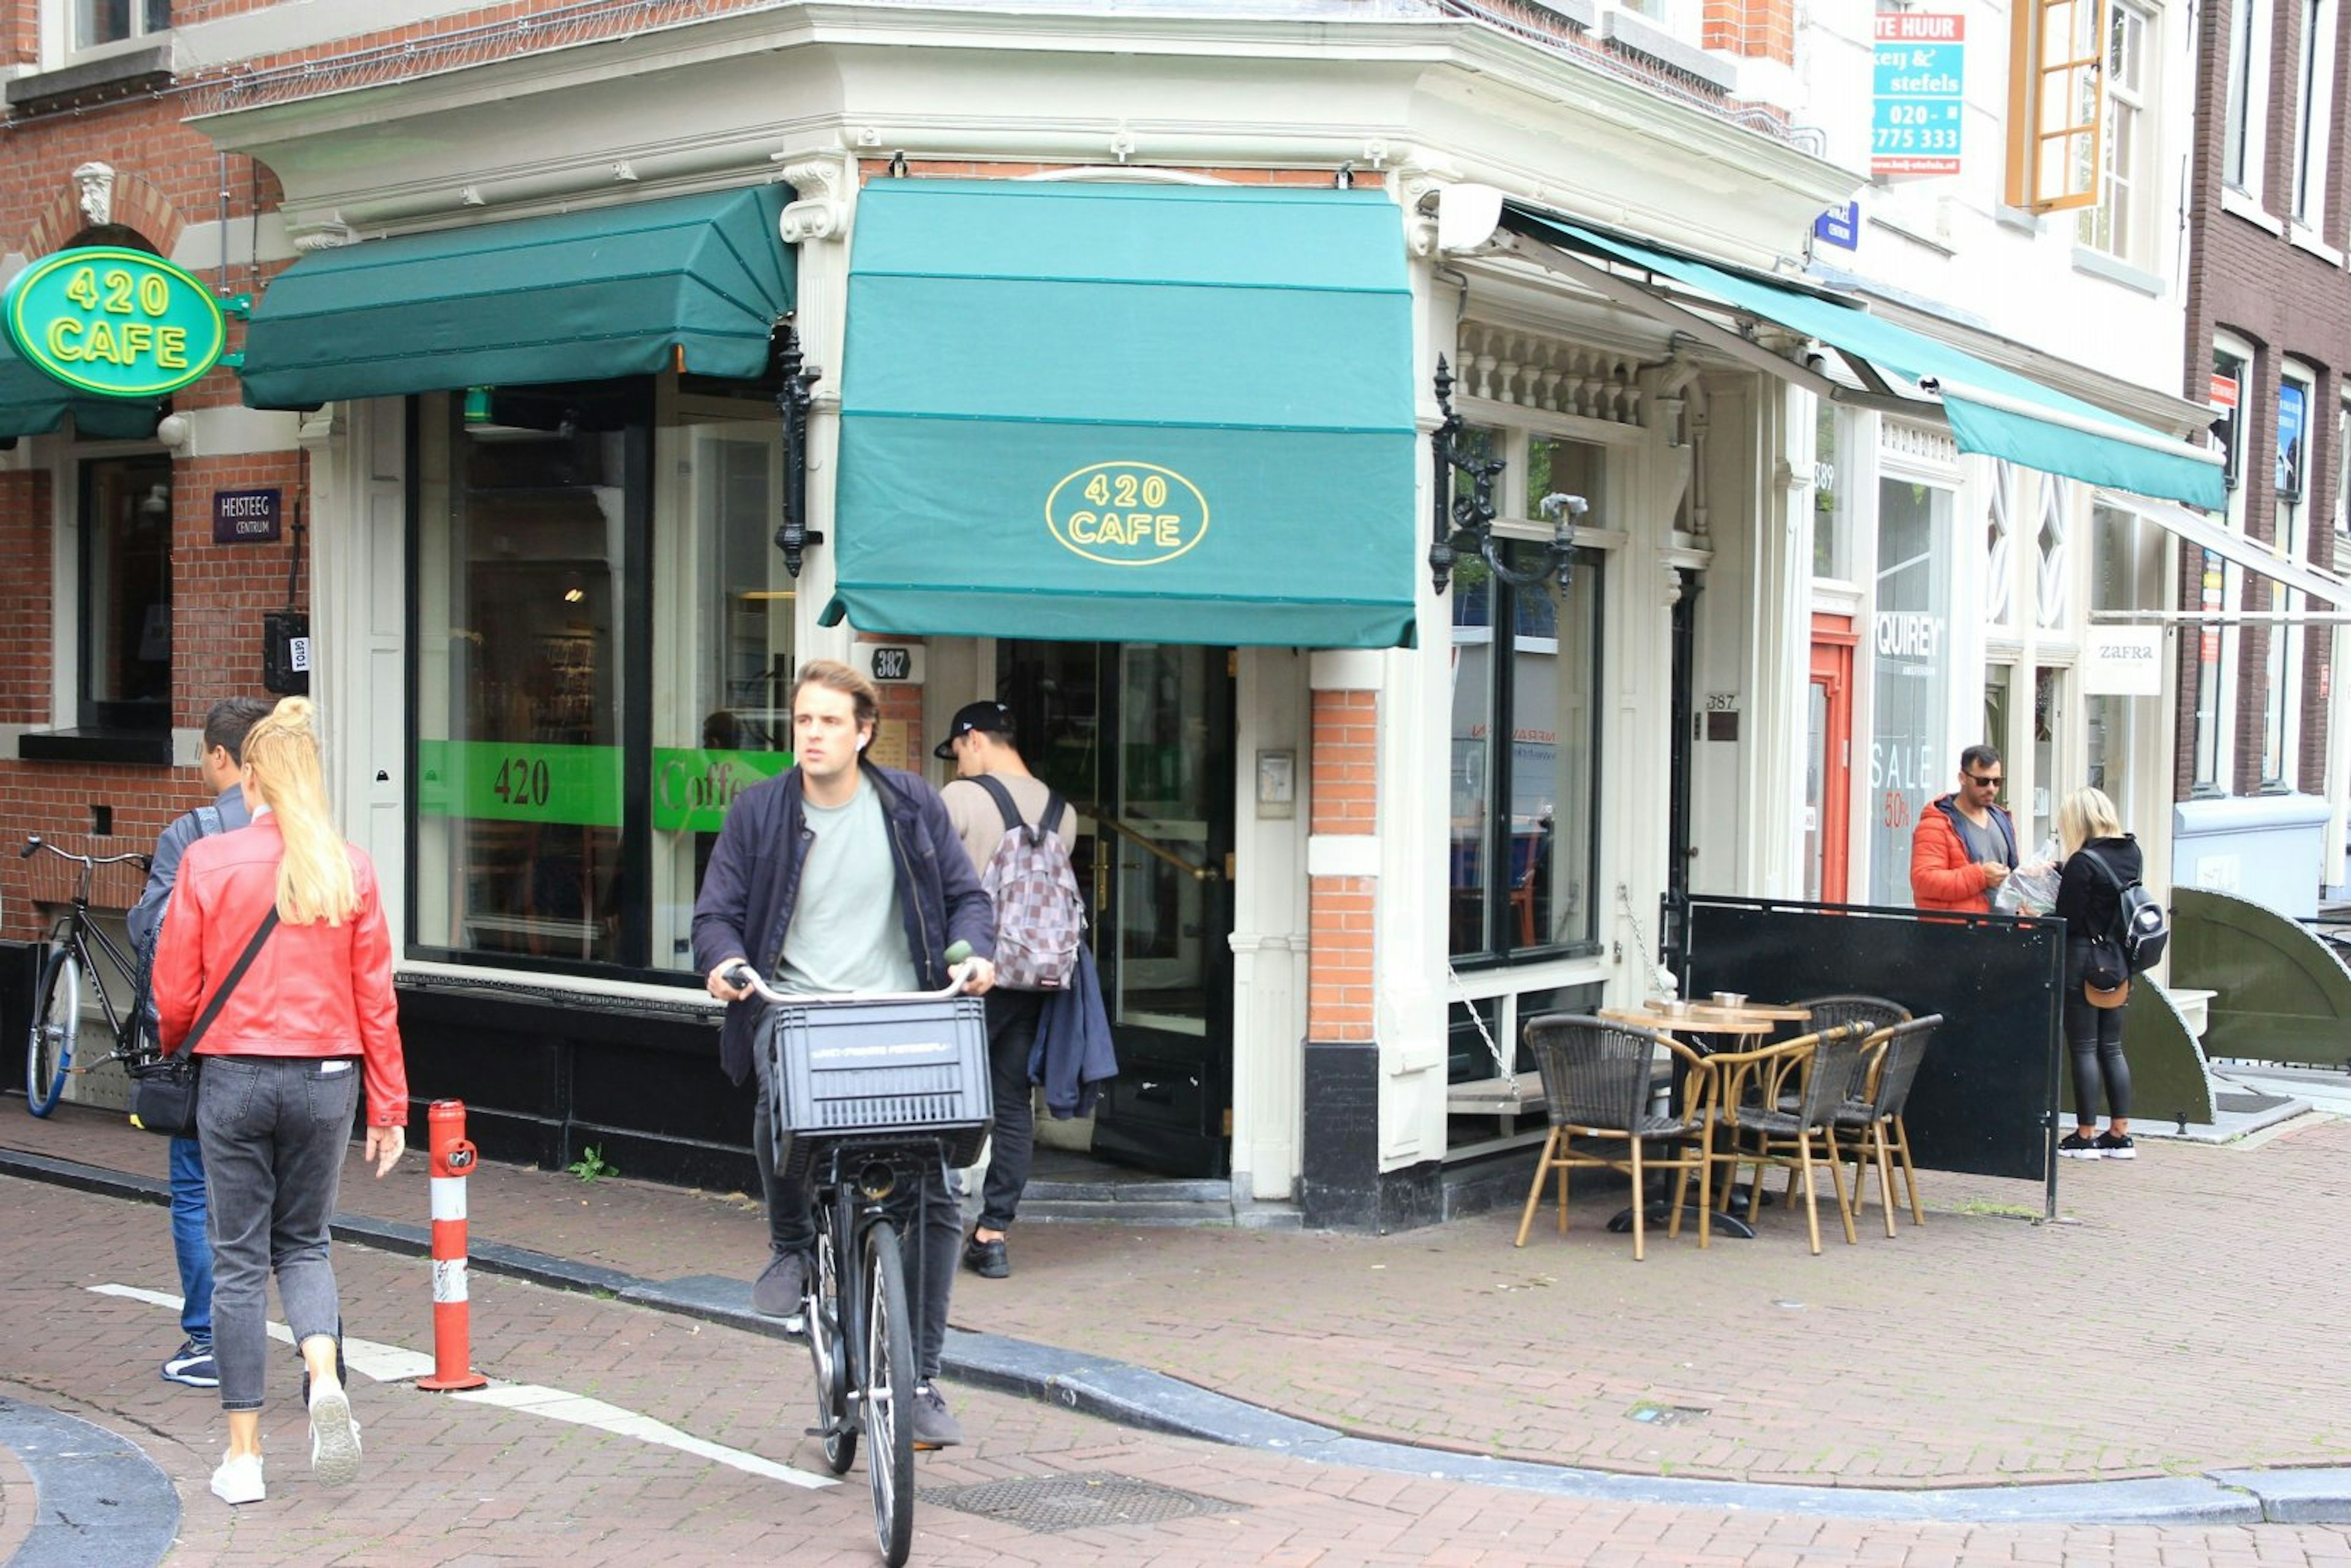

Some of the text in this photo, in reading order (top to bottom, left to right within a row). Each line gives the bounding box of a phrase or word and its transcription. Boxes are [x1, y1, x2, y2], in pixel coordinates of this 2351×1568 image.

[1875, 16, 1955, 38] TE HUUR
[1911, 48, 1937, 67] &
[1891, 73, 1959, 92] stefels
[1920, 129, 1957, 148] 333
[66, 266, 170, 317] 420
[46, 317, 189, 369] CAFE
[1084, 473, 1168, 509] 420
[220, 496, 269, 518] HEISTEEG
[235, 520, 269, 535] CENTRUM
[1068, 511, 1182, 547] CAFE
[877, 650, 905, 678] 387
[1706, 694, 1735, 710] 387
[1872, 742, 1932, 789] SALE
[493, 757, 549, 807] 420
